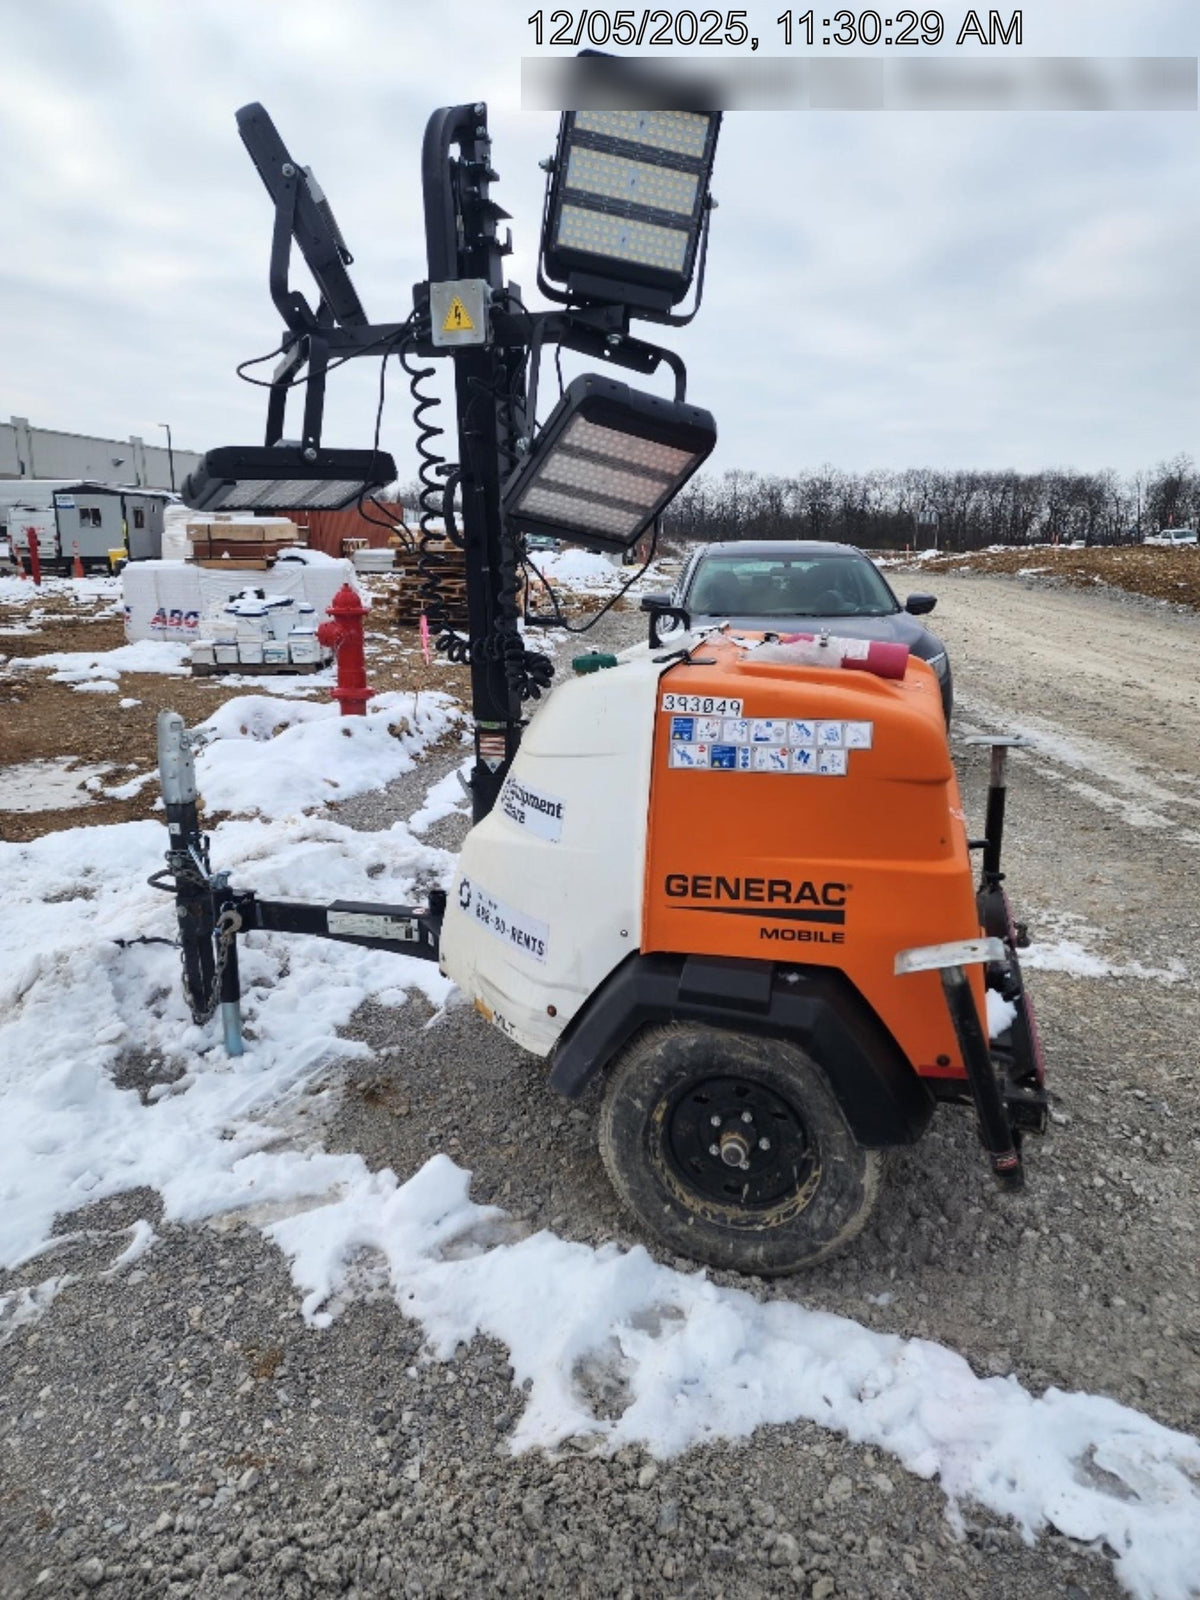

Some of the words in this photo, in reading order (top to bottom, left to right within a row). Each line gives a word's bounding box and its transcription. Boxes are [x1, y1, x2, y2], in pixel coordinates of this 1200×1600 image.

[664, 695, 740, 716] 393049
[665, 874, 846, 906] GENERAC
[760, 927, 845, 944] MOBILE
